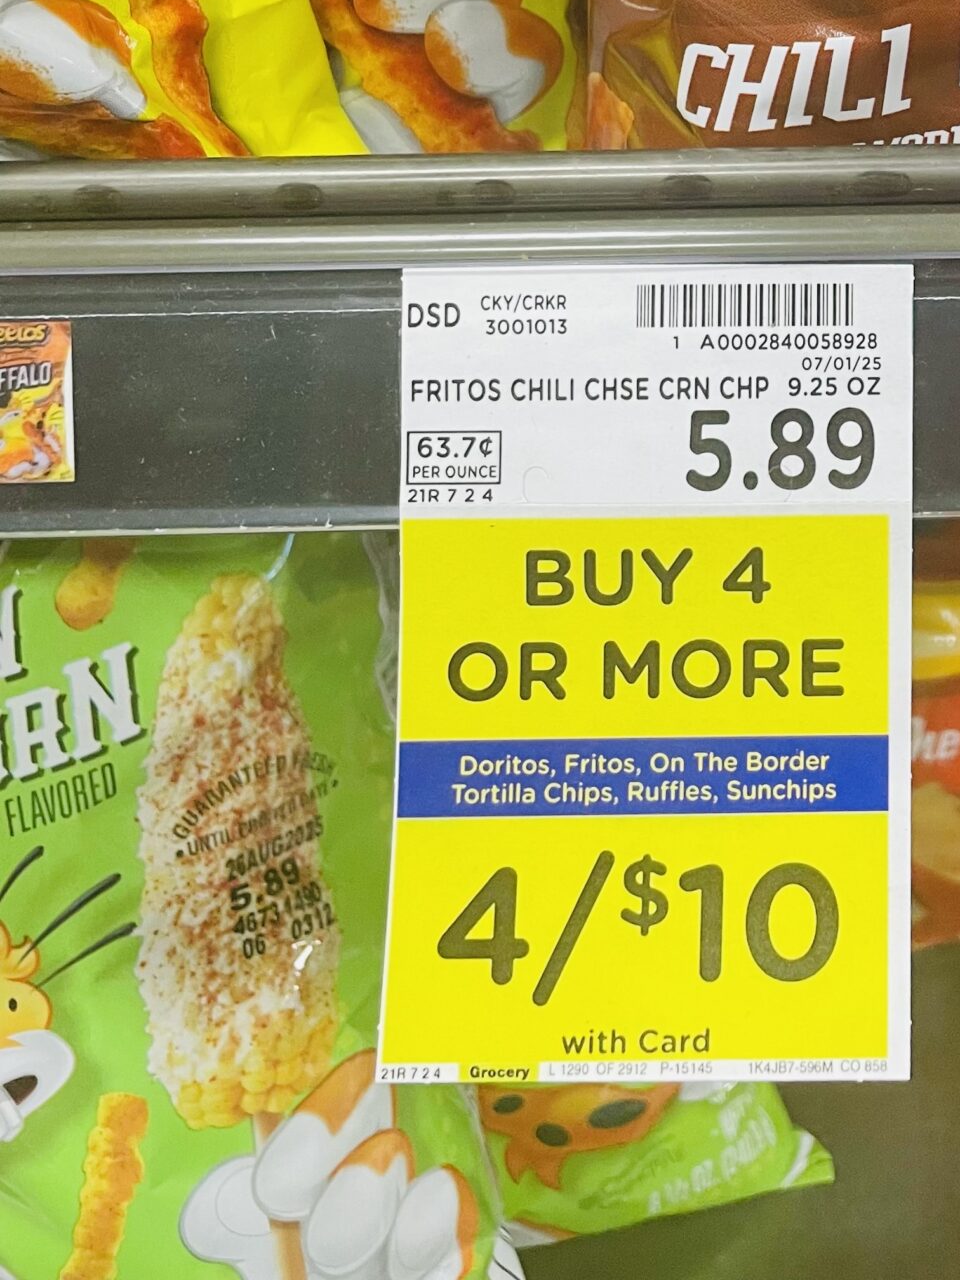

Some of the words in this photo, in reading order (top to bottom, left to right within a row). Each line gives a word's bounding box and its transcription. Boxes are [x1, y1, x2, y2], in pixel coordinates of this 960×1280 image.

[676, 23, 913, 132] CHILI
[407, 302, 461, 329] DSD
[479, 294, 568, 312] CKY/CRKR
[484, 318, 569, 336] 3001013
[699, 332, 879, 352] A0002840058928
[800, 355, 883, 373] 07/01/25
[410, 378, 502, 403] FRITOS
[510, 377, 576, 402] CHILI
[583, 376, 650, 401] CHSE
[658, 376, 710, 401] CRN
[718, 375, 770, 400] CHP
[787, 376, 839, 397] 9.25
[846, 375, 882, 397] OZ
[416, 435, 494, 460] 63.7¢
[685, 406, 876, 492] 5.89
[411, 464, 442, 480] PER
[444, 463, 499, 480] OUNCE
[407, 488, 440, 504] 21R
[525, 547, 694, 607] BUY
[722, 546, 772, 604] 4
[447, 640, 568, 703] OR
[602, 638, 846, 700] MORE
[459, 755, 557, 778] Doritos,
[564, 754, 642, 777] Fritos,
[649, 752, 686, 773] On
[694, 752, 738, 773] The
[745, 751, 830, 773] Border
[5, 762, 117, 837] FLAVORED
[451, 782, 537, 805] Tortilla
[542, 782, 619, 807] Chips,
[626, 781, 720, 804] Ruffles,
[726, 779, 838, 804] Sunchips
[230, 857, 300, 911] 5.89
[436, 849, 841, 1007] 4/$10
[561, 1029, 627, 1055] with
[638, 1027, 713, 1054] Card
[380, 1064, 406, 1081] 21R
[469, 1065, 530, 1081] Grocery
[560, 1062, 589, 1076] 1290
[596, 1062, 616, 1076] OF
[617, 1061, 647, 1075] 2912
[659, 1060, 713, 1075] P-15145
[840, 1059, 860, 1073] CO
[864, 1058, 888, 1072] 858
